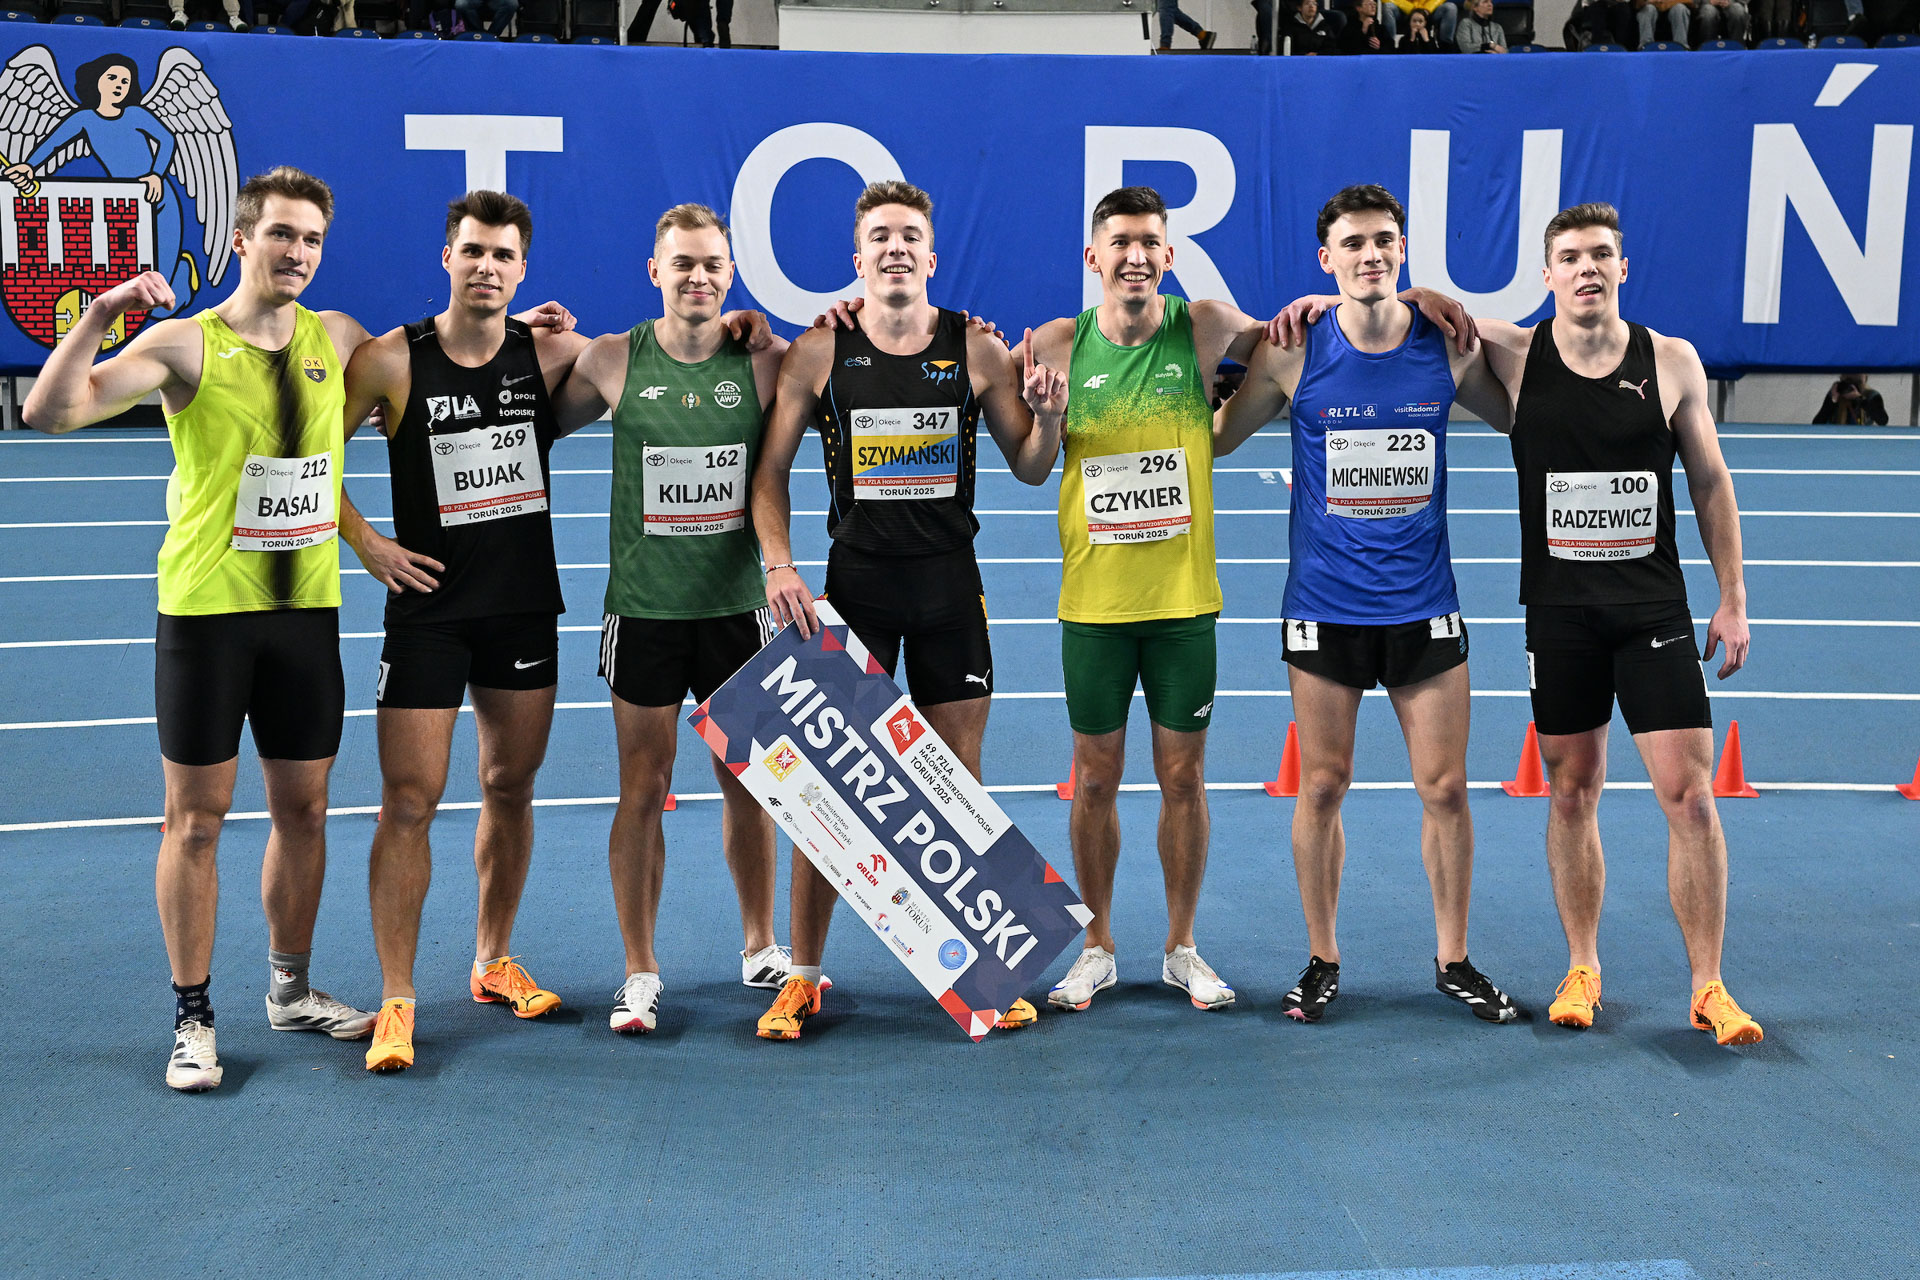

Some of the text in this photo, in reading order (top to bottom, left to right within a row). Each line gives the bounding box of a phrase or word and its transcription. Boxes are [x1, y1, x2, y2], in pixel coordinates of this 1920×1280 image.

[404, 63, 1914, 327] TORUŃ
[921, 362, 959, 386] Sopot
[1083, 373, 1110, 389] 4F
[639, 386, 668, 400] 4F
[1328, 407, 1360, 418] RLTL
[1394, 405, 1440, 413] visitRadom.pl
[913, 412, 950, 430] 347
[459, 442, 481, 450] Okęcie
[491, 429, 526, 450] 269
[1387, 434, 1426, 452] 223
[705, 450, 738, 468] 162
[858, 441, 954, 466] SZYMAŃSKI
[270, 469, 294, 477] Okęcie
[300, 458, 328, 480] 212
[1106, 464, 1128, 473] Okęcie
[1140, 454, 1178, 474] 296
[454, 462, 525, 492] BUJAK
[1332, 466, 1428, 487] MICHNIEWSKI
[1610, 476, 1648, 494] 100
[660, 482, 732, 504] KILJAN
[879, 486, 912, 496] TORUŃ
[1090, 486, 1182, 514] CZYKIER
[257, 492, 319, 517] BASAJ
[467, 504, 522, 520] TORUŃ 2025
[1352, 507, 1384, 516] TORUŃ
[670, 523, 724, 532] TORUŃ 2025
[1552, 507, 1652, 528] RADZEWICZ
[262, 538, 294, 548] TORUŃ
[1113, 530, 1168, 540] TORUŃ 2025
[1573, 548, 1630, 558] TORUŃ 2025
[1194, 702, 1213, 718] 4F
[925, 743, 954, 776] 69. PZLA
[910, 756, 952, 805] TORUŃ 2025
[919, 749, 994, 836] HALOWE MISTRZOSTWA POLSKI
[759, 655, 1039, 970] MISTRZ POLSKI
[821, 798, 849, 830] Ministerstwo
[816, 804, 831, 823] Sportu
[832, 822, 853, 846] Turystyki
[856, 862, 879, 887] ORLEN
[860, 898, 872, 912] SPORT
[911, 902, 930, 923] MIASTO
[904, 904, 932, 934] TORUŃ
